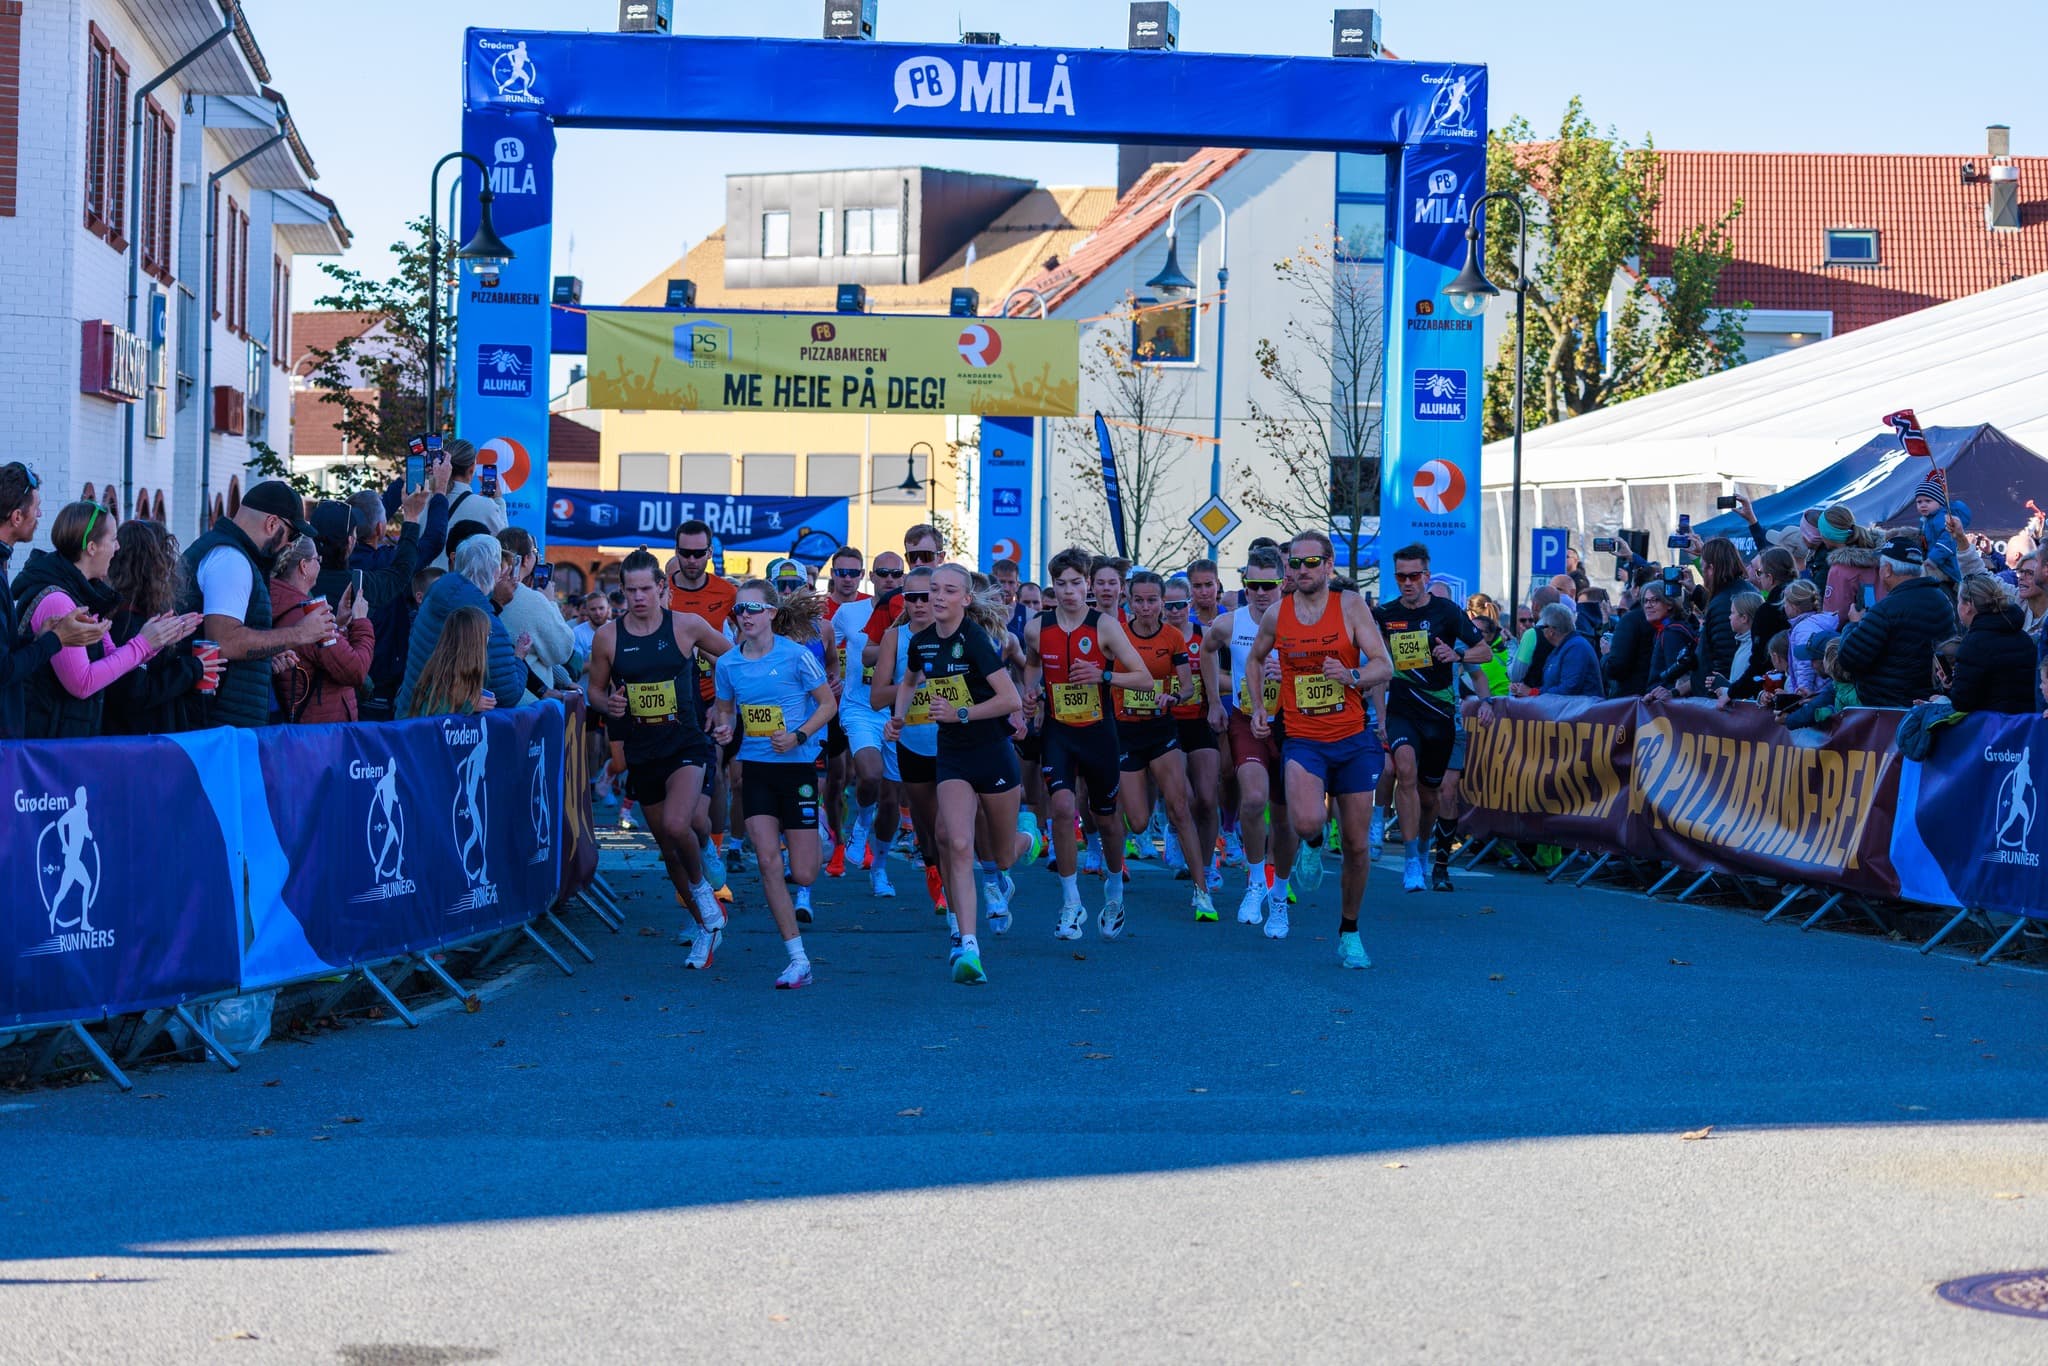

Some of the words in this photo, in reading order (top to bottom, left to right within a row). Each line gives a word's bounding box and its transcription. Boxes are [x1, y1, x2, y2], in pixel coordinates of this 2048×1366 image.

[909, 64, 943, 99] PB
[960, 53, 1075, 116] MILÅ
[1440, 128, 1478, 138] RUNNERS
[501, 141, 518, 159] PB
[480, 163, 537, 194] MILÅ
[1435, 173, 1452, 191] PB
[1414, 193, 1469, 224] MILÅ
[471, 291, 540, 305] PIZZABAKEREN
[815, 324, 831, 339] PB
[1407, 318, 1473, 331] PIZZABAKEREN
[689, 333, 717, 353] PS
[800, 346, 887, 362] PIZZABAKEREN
[483, 378, 527, 392] ALUHAK
[723, 373, 763, 407] ME
[774, 374, 832, 408] HEIE
[842, 366, 877, 409] PÅ
[886, 376, 947, 410] DEG!
[1419, 402, 1461, 415] ALUHAK
[638, 500, 673, 533] DU
[704, 496, 753, 535] RÅ!!
[1411, 521, 1467, 530] RANDABERG
[1541, 535, 1560, 571] P
[912, 691, 931, 706] 534
[1064, 692, 1088, 706] 5387
[1306, 684, 1333, 699] 3075
[639, 694, 665, 709] 3078
[748, 708, 771, 723] 5428
[1984, 745, 2022, 763] Grødem
[1459, 717, 1621, 819] ZZABAKEREN
[14, 788, 69, 813] Grødem
[2000, 850, 2040, 867] RUNNERS
[60, 928, 115, 953] RUNNERS
